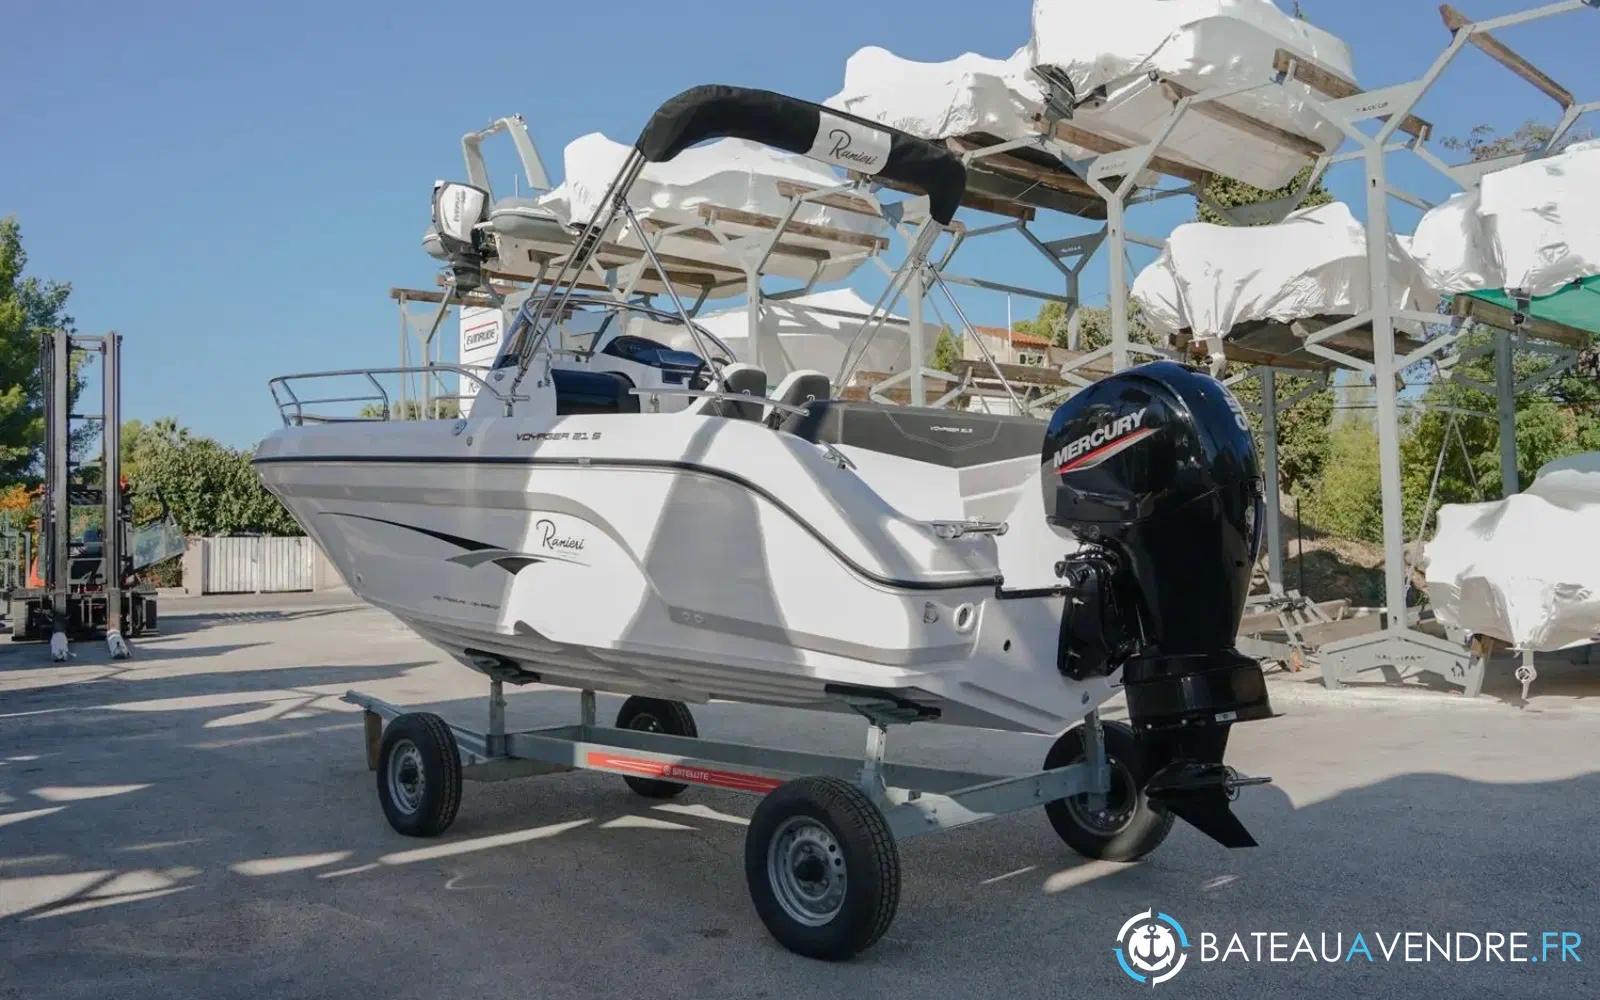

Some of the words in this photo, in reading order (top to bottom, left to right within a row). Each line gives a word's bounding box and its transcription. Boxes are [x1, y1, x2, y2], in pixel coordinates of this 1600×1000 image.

[829, 129, 878, 164] Ranieri
[516, 432, 570, 441] VOYAGER
[1053, 407, 1147, 468] MERCURY
[535, 519, 585, 550] Ranieri
[672, 767, 710, 781] SATELLITE
